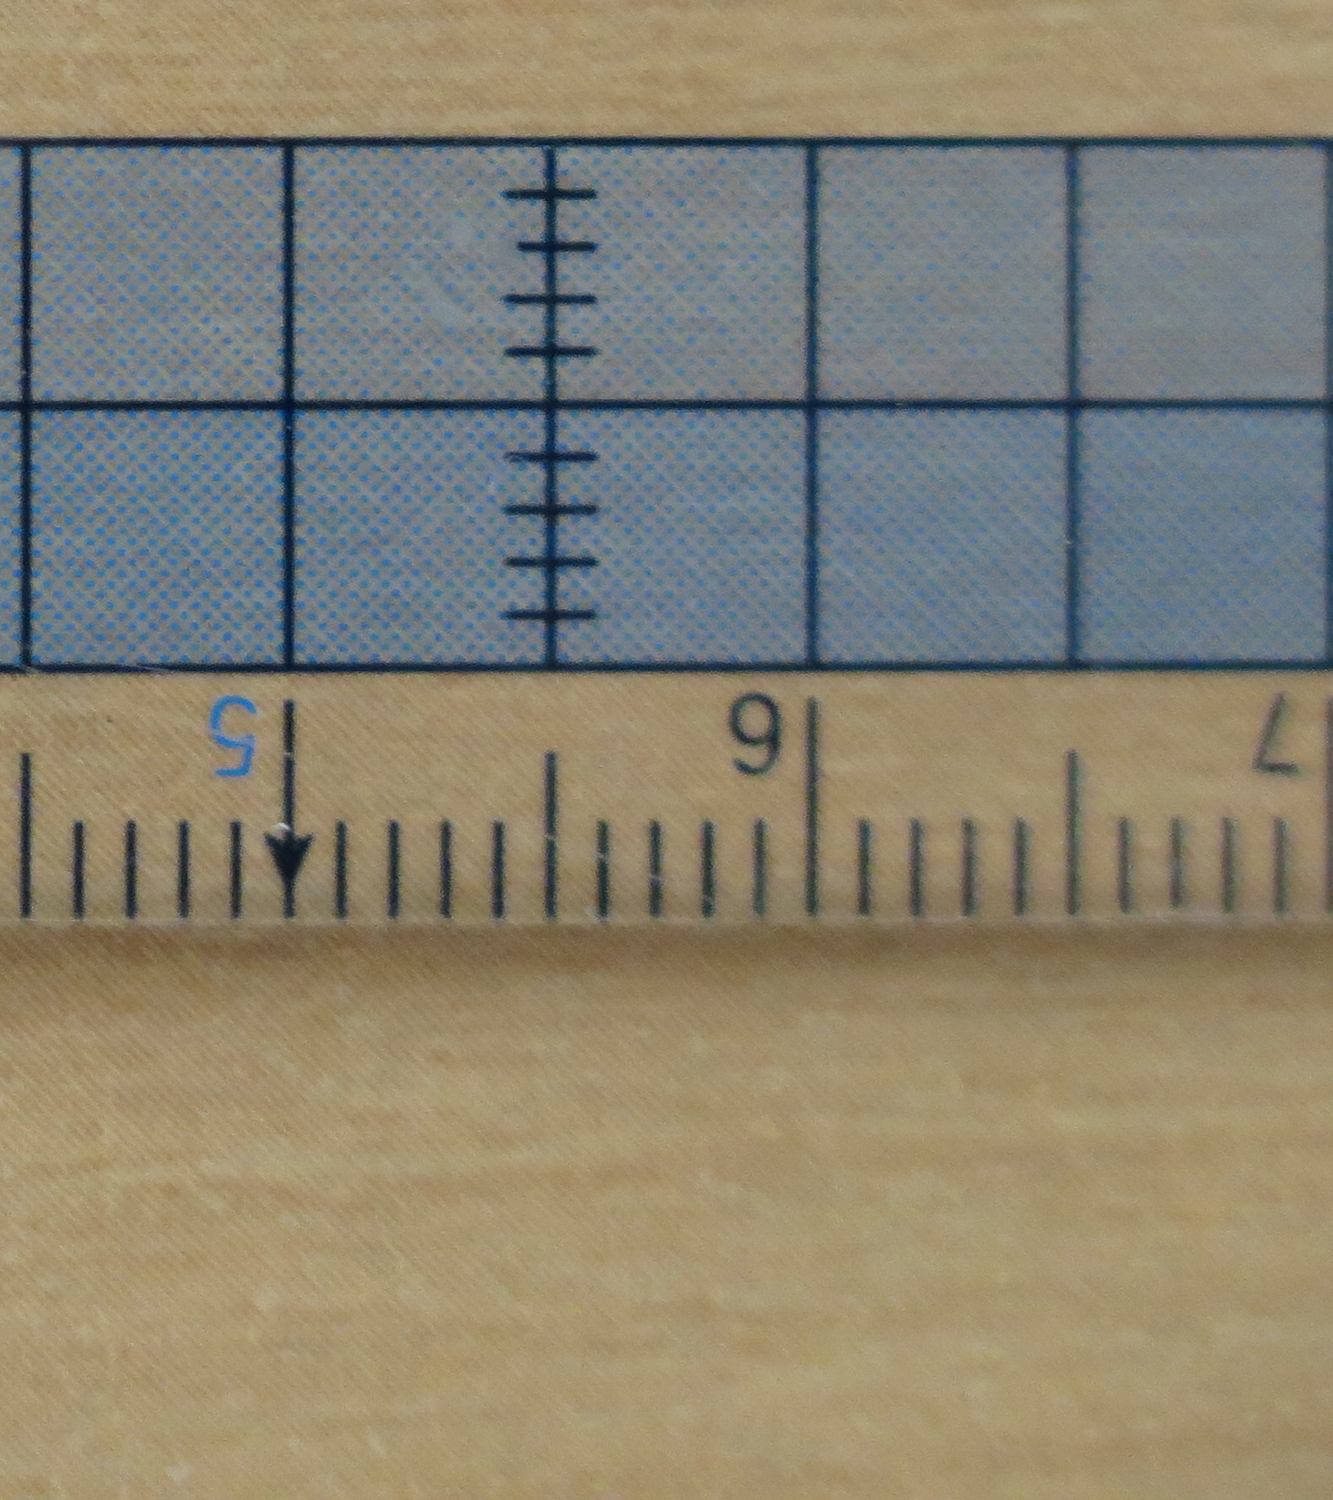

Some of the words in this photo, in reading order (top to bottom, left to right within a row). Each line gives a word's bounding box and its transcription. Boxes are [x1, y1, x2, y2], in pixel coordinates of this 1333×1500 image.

[207, 694, 259, 779] 5
[725, 691, 785, 779] 6
[1252, 692, 1301, 779] 7
